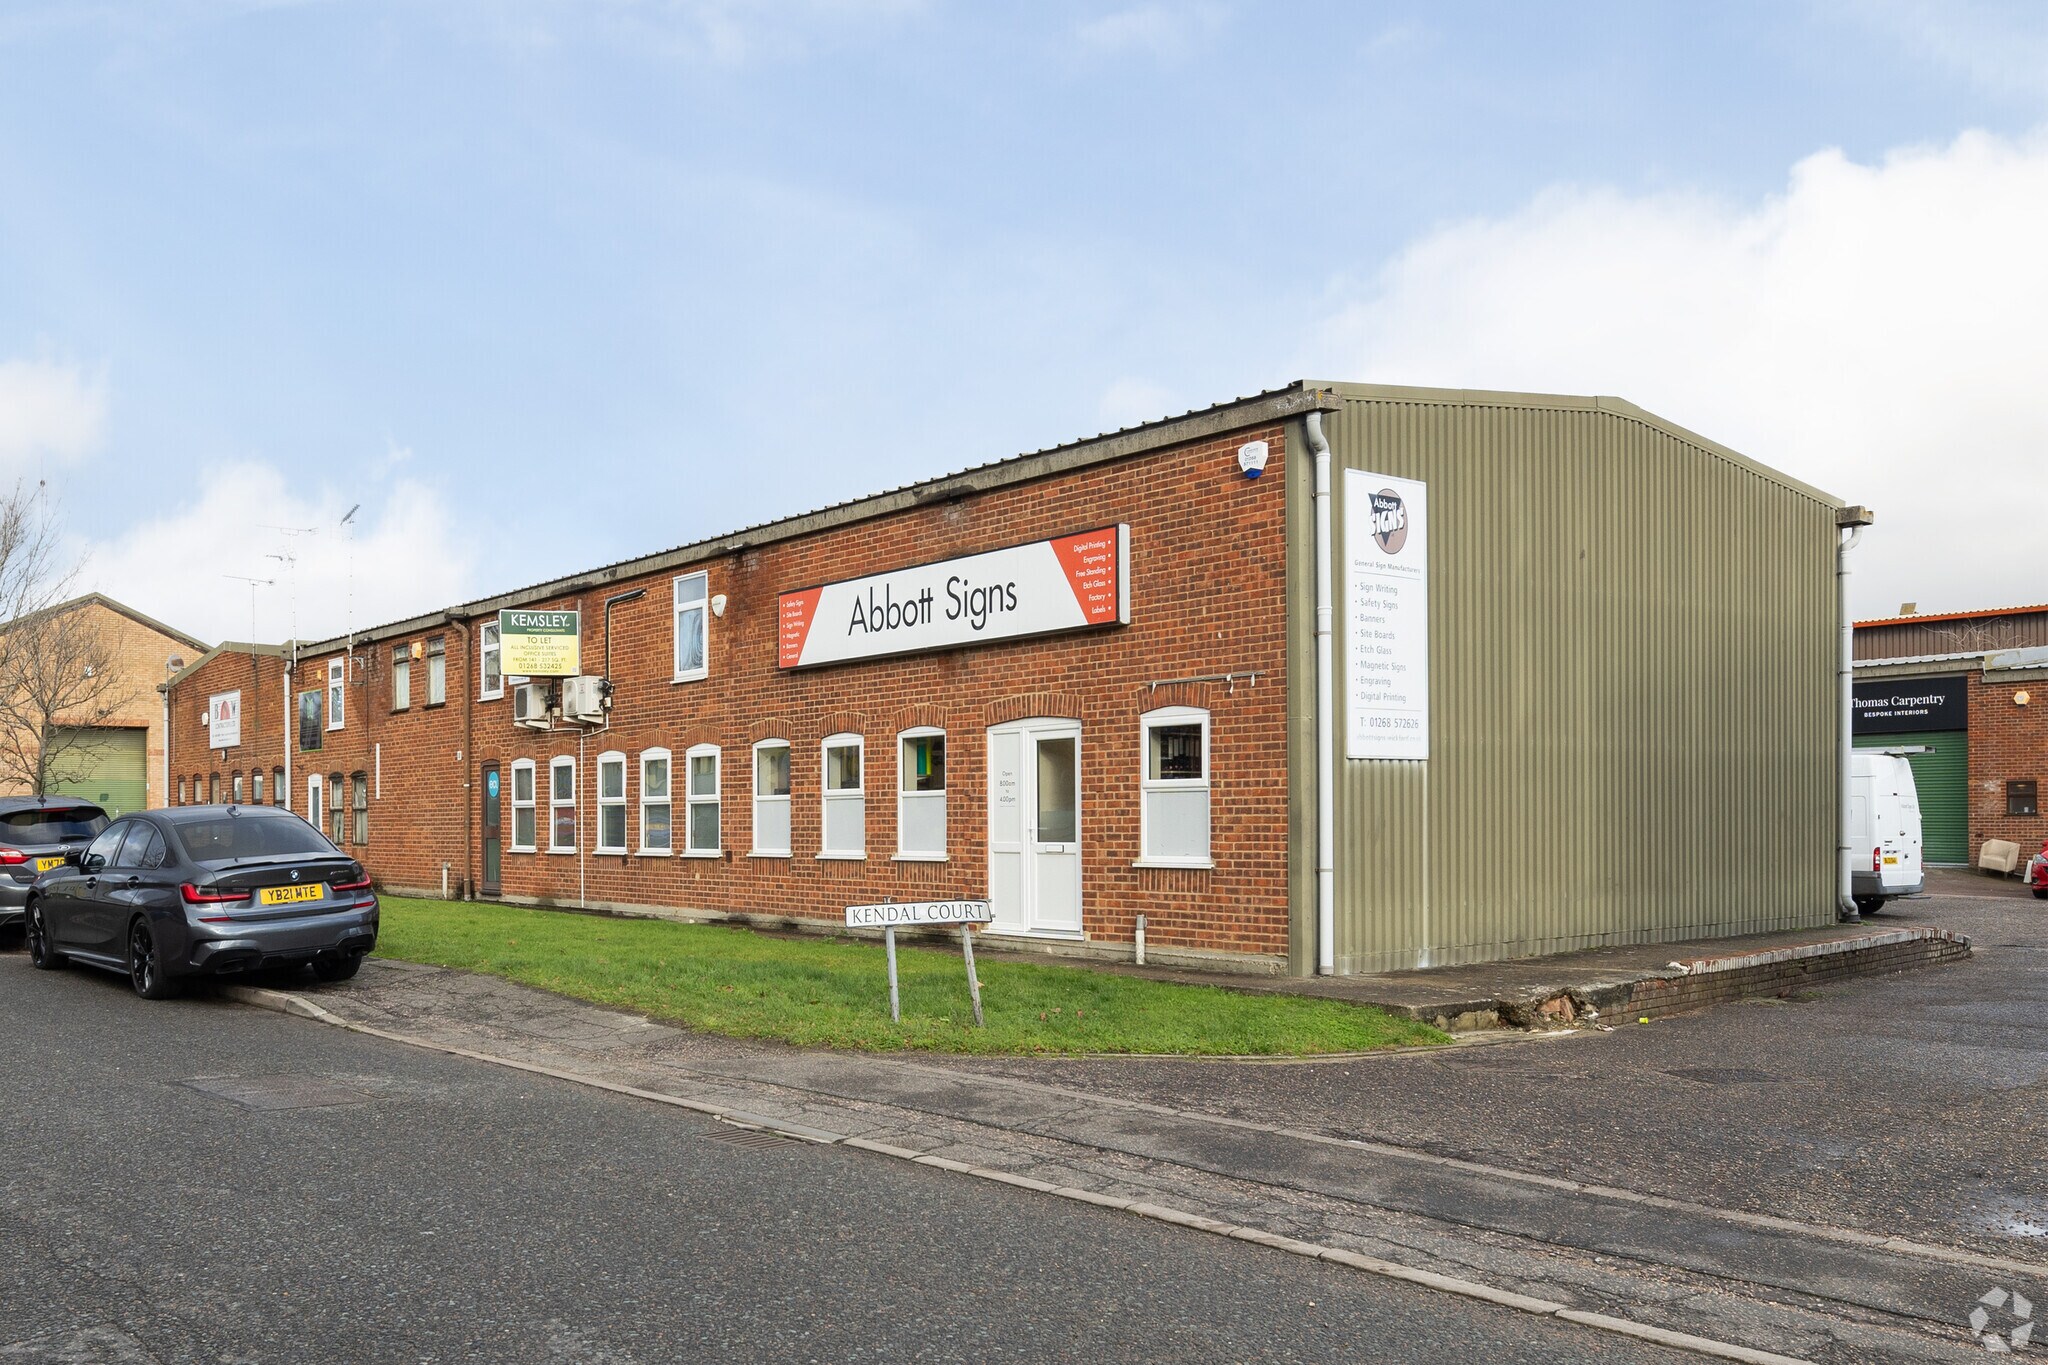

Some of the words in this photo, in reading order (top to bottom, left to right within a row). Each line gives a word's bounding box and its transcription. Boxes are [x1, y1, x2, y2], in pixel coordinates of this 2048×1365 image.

[1374, 498, 1397, 510] Abbott
[1370, 508, 1404, 536] SIGNS
[1074, 543, 1088, 553] Digital
[1089, 541, 1106, 550] Printing
[1083, 554, 1106, 564] Engraving
[1354, 560, 1374, 568] General
[1376, 561, 1386, 570] Sign
[1086, 566, 1106, 576] Standing
[1083, 581, 1092, 589] Etch
[1360, 582, 1374, 593] Sign
[1376, 584, 1398, 596] Writing
[1088, 594, 1105, 602] Factory
[848, 582, 934, 636] Abbott
[946, 576, 1017, 630] Signs
[1092, 605, 1105, 614] Labels
[1360, 598, 1380, 609] Safety
[1383, 600, 1398, 611] Signs
[511, 614, 568, 627] KEMSLEY
[1360, 613, 1385, 624] Banners
[1360, 629, 1372, 639] Site
[1374, 630, 1395, 640] Boards
[1360, 644, 1374, 654] Etch
[1376, 646, 1392, 655] Glass
[1360, 660, 1389, 672] Magnetic
[1391, 662, 1406, 673] Signs
[1360, 675, 1391, 687] Engraving
[1360, 691, 1381, 703] Digital
[1383, 692, 1407, 704] Printing
[1851, 698, 1889, 708] Thomas
[1891, 695, 1945, 707] Carpentry
[1360, 717, 1366, 727] T:
[1369, 717, 1391, 728] 01268
[1394, 718, 1419, 729] 572626
[268, 888, 293, 901] YB21
[853, 906, 920, 924] KENDAL
[928, 904, 983, 920] COURT
